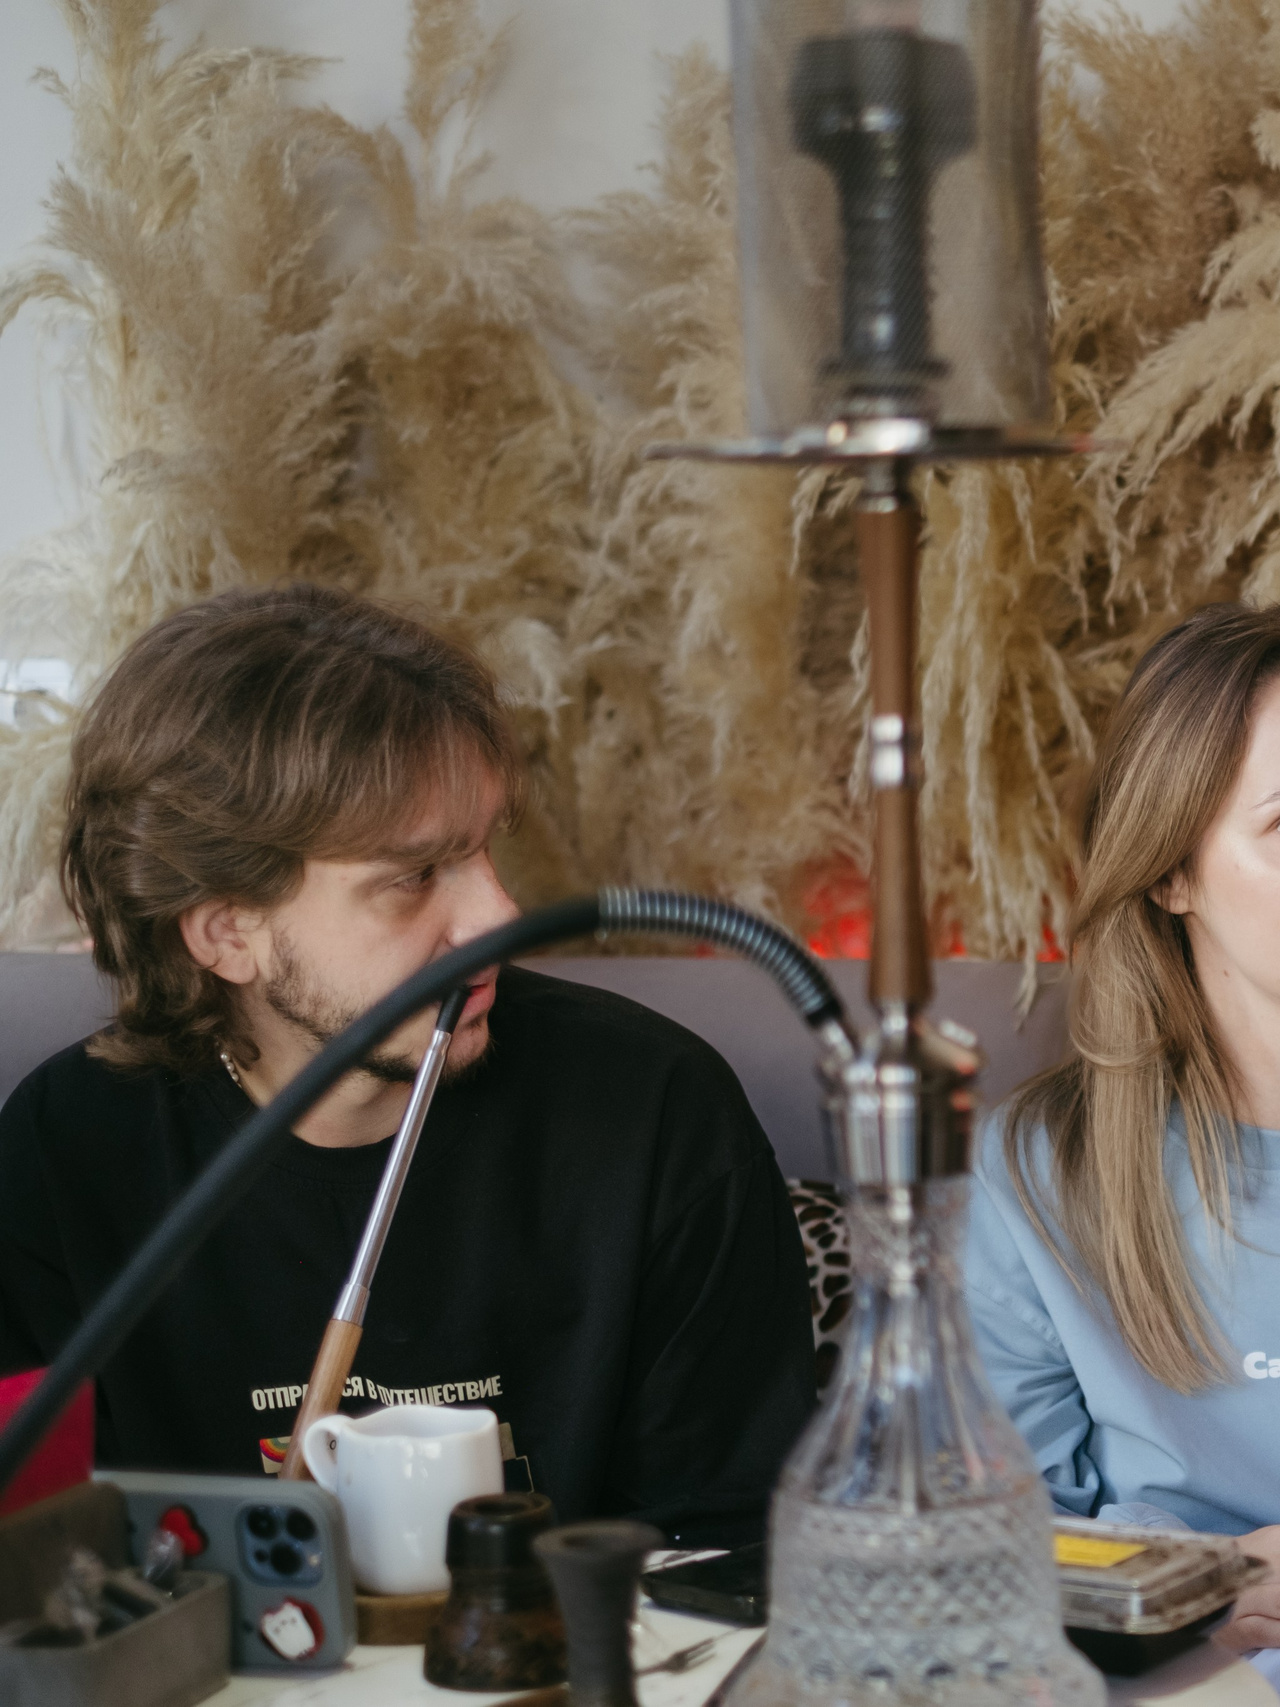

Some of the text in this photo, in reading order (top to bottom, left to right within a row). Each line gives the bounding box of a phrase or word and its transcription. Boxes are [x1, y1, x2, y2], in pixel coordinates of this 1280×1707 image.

[252, 1375, 503, 1411] ОТПРСЯ В ПУТЕШЕСТВИЕ
